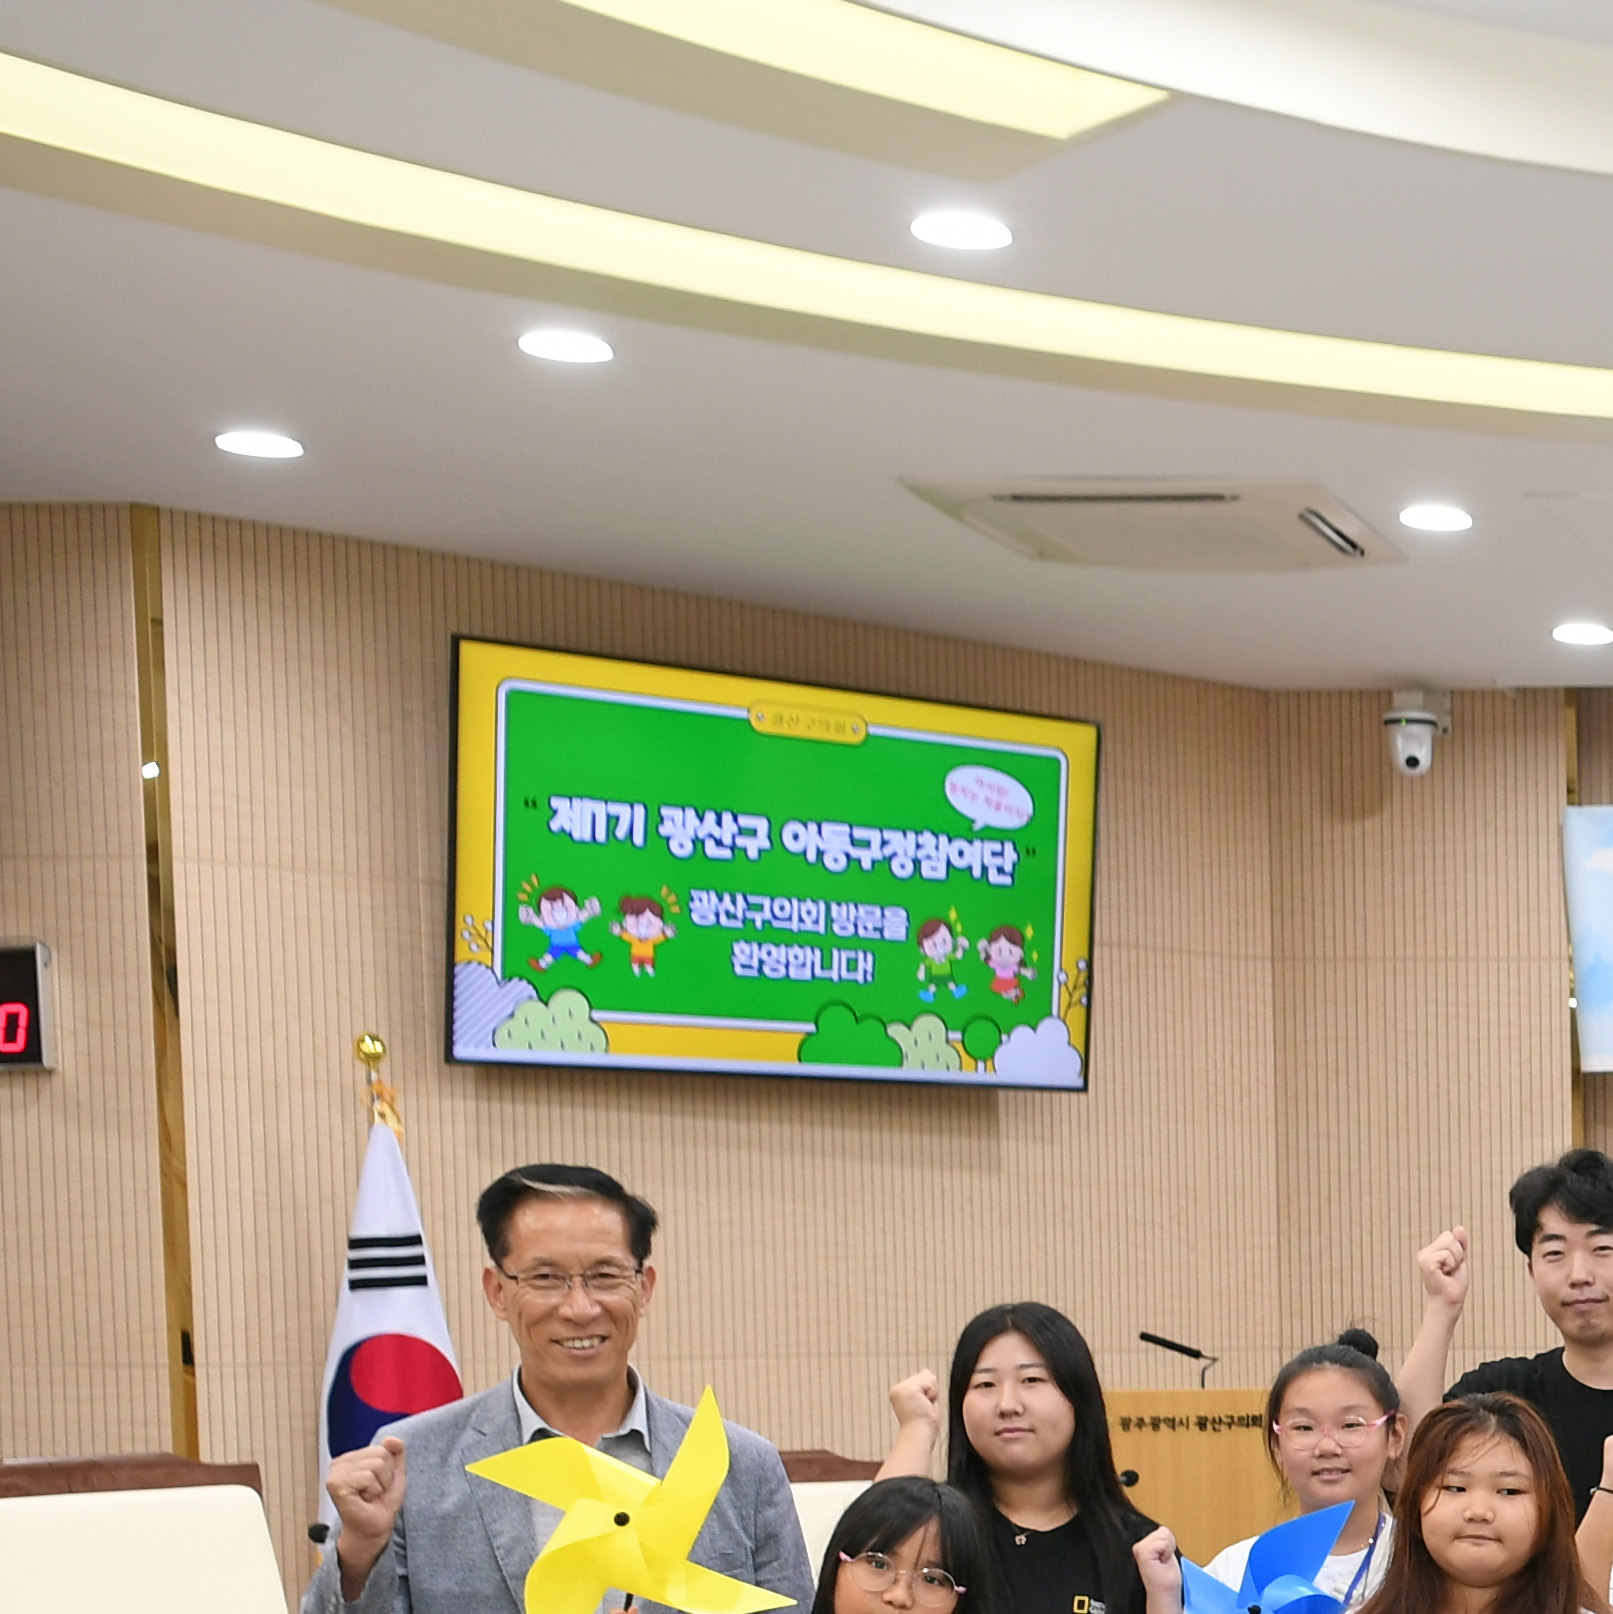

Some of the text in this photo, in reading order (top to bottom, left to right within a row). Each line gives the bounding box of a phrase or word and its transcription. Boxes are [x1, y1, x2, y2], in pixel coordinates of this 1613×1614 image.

[657, 803, 774, 862] 광산구
[780, 819, 1019, 888] 아동구정참여단
[688, 888, 827, 936] 광산구의회
[1119, 1412, 1263, 1432] 광주광역시 광산구의회
